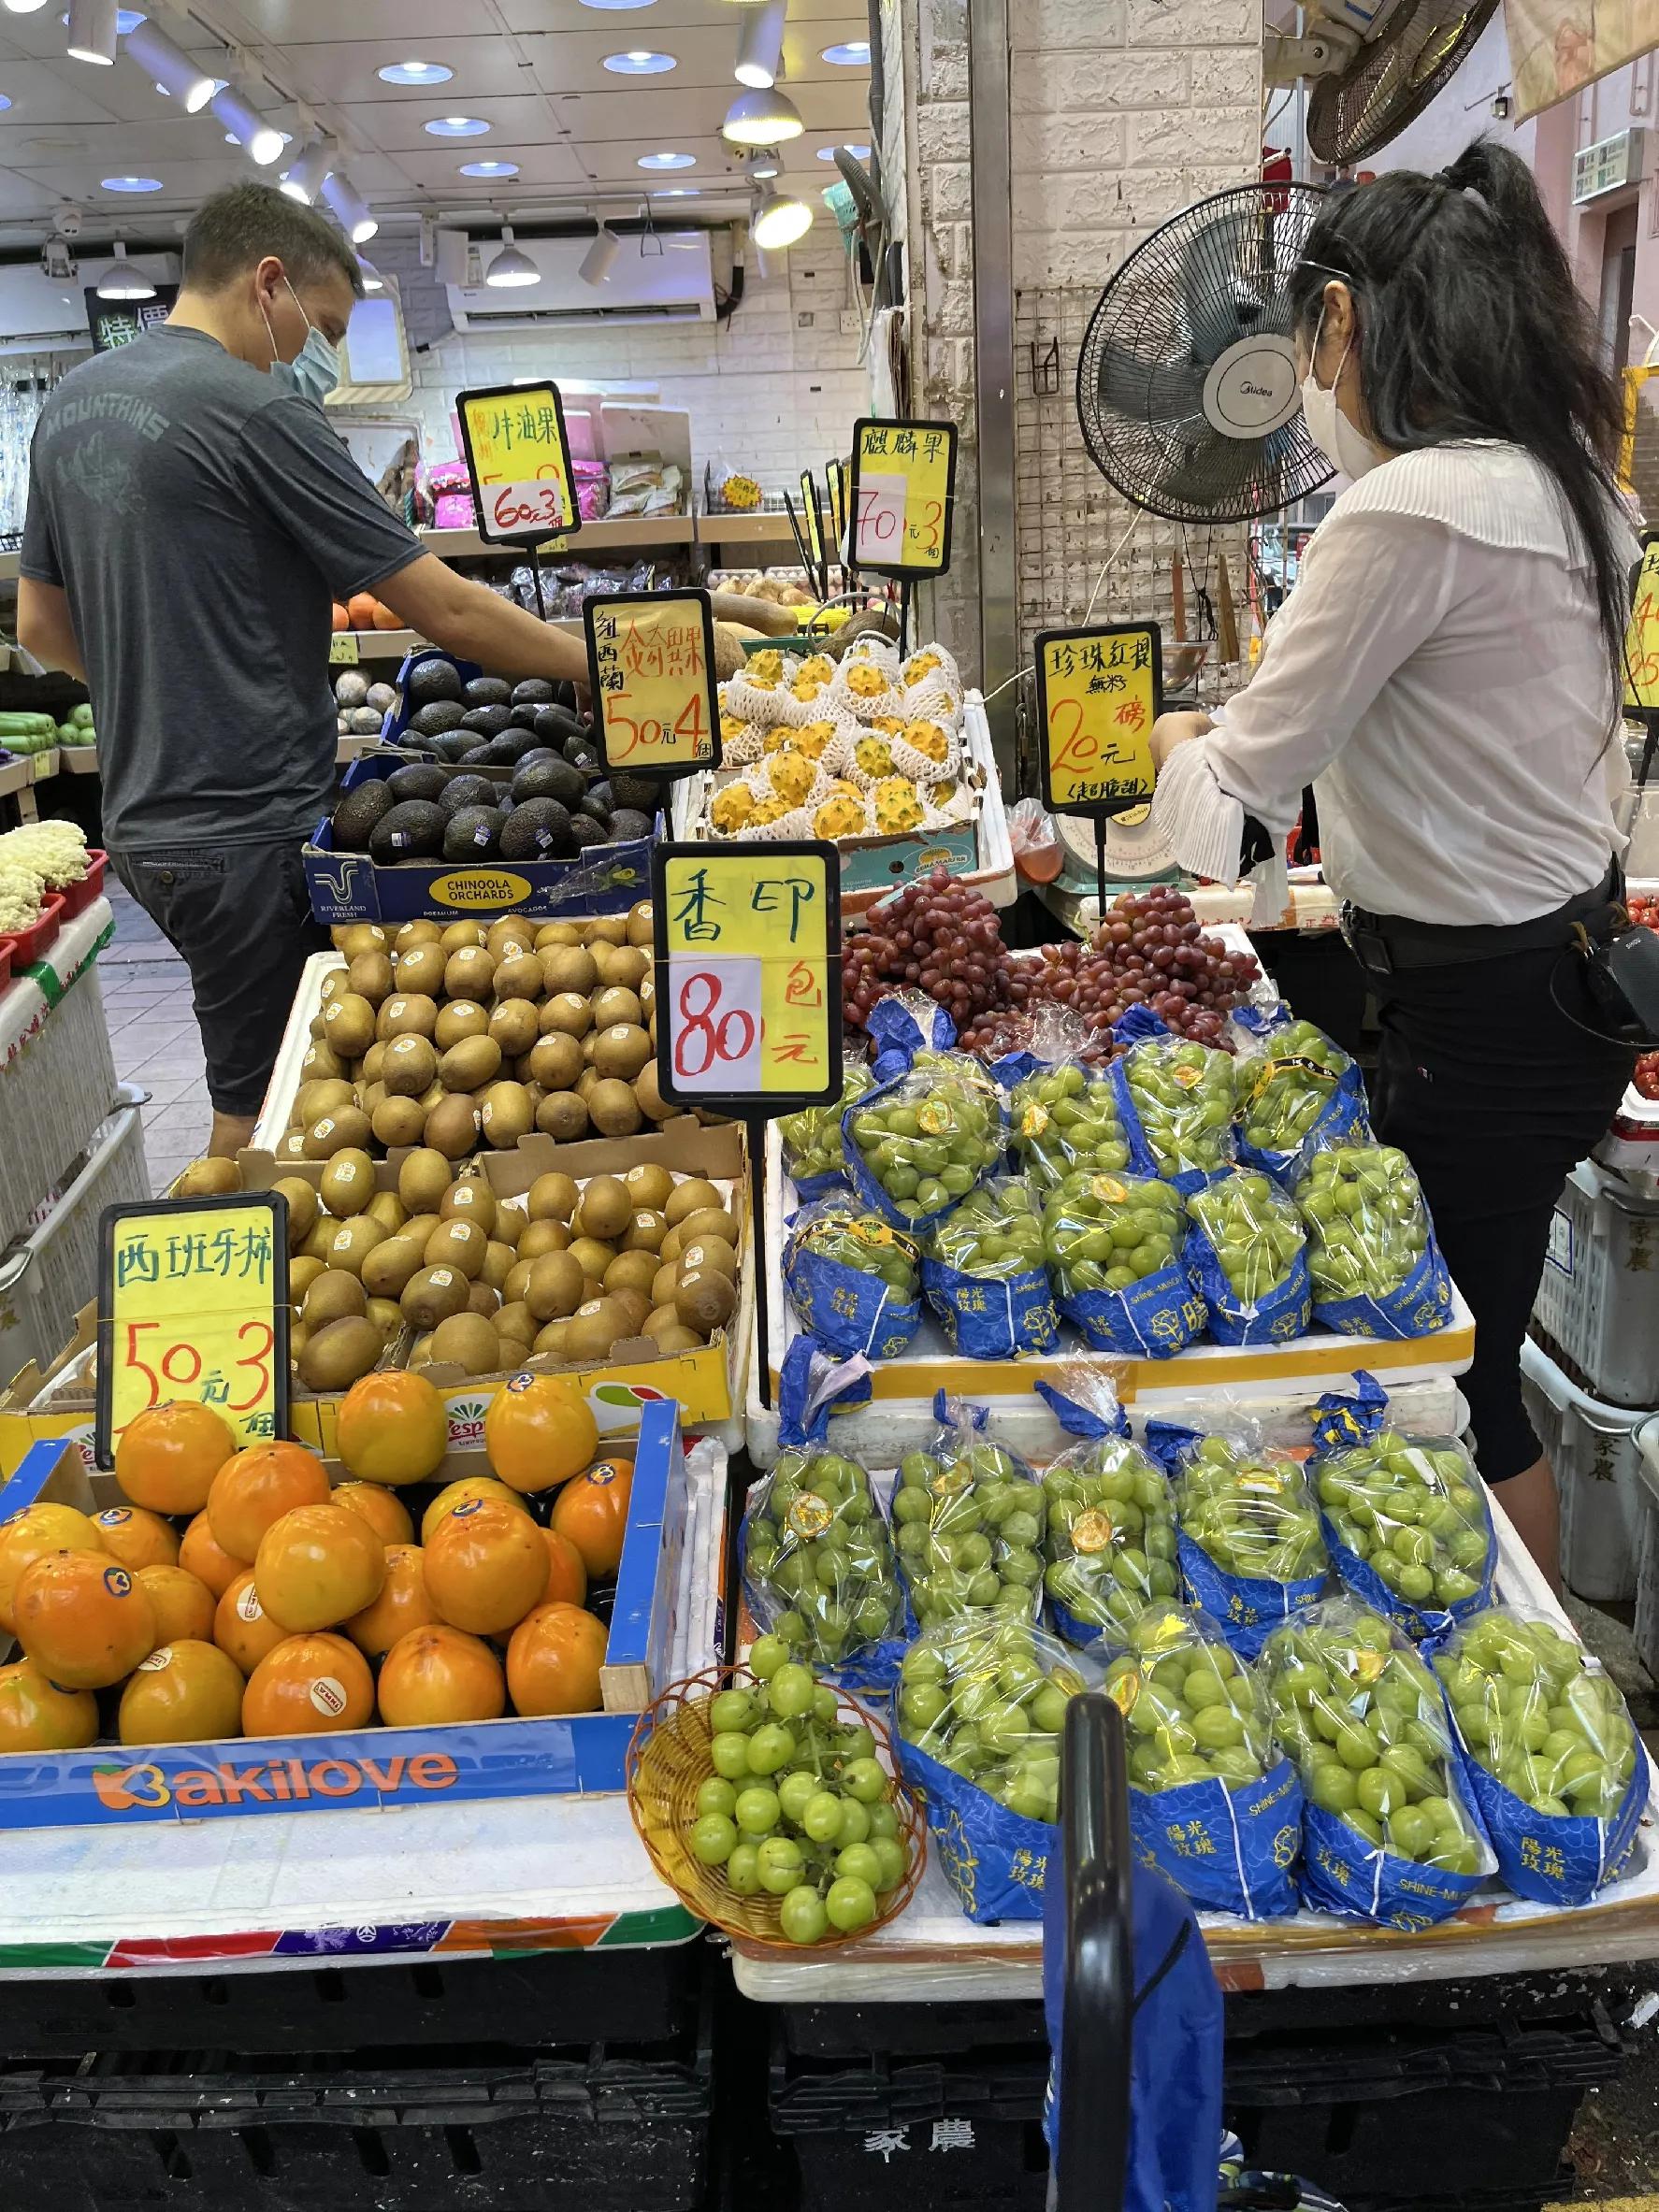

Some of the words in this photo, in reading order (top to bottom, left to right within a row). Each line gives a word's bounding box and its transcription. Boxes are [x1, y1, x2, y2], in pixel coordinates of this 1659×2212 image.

[46, 393, 171, 442] MOUNTAINS
[1047, 637, 1151, 678] 珍珠紅提
[447, 879, 512, 891] CHINOOLA
[449, 889, 514, 901] ORCHARDS
[1166, 1820, 1208, 1842] 陽光
[1176, 1836, 1217, 1857] 玫瑰
[1522, 1836, 1565, 1864] 陽光
[1521, 1853, 1565, 1880] 玫瑰
